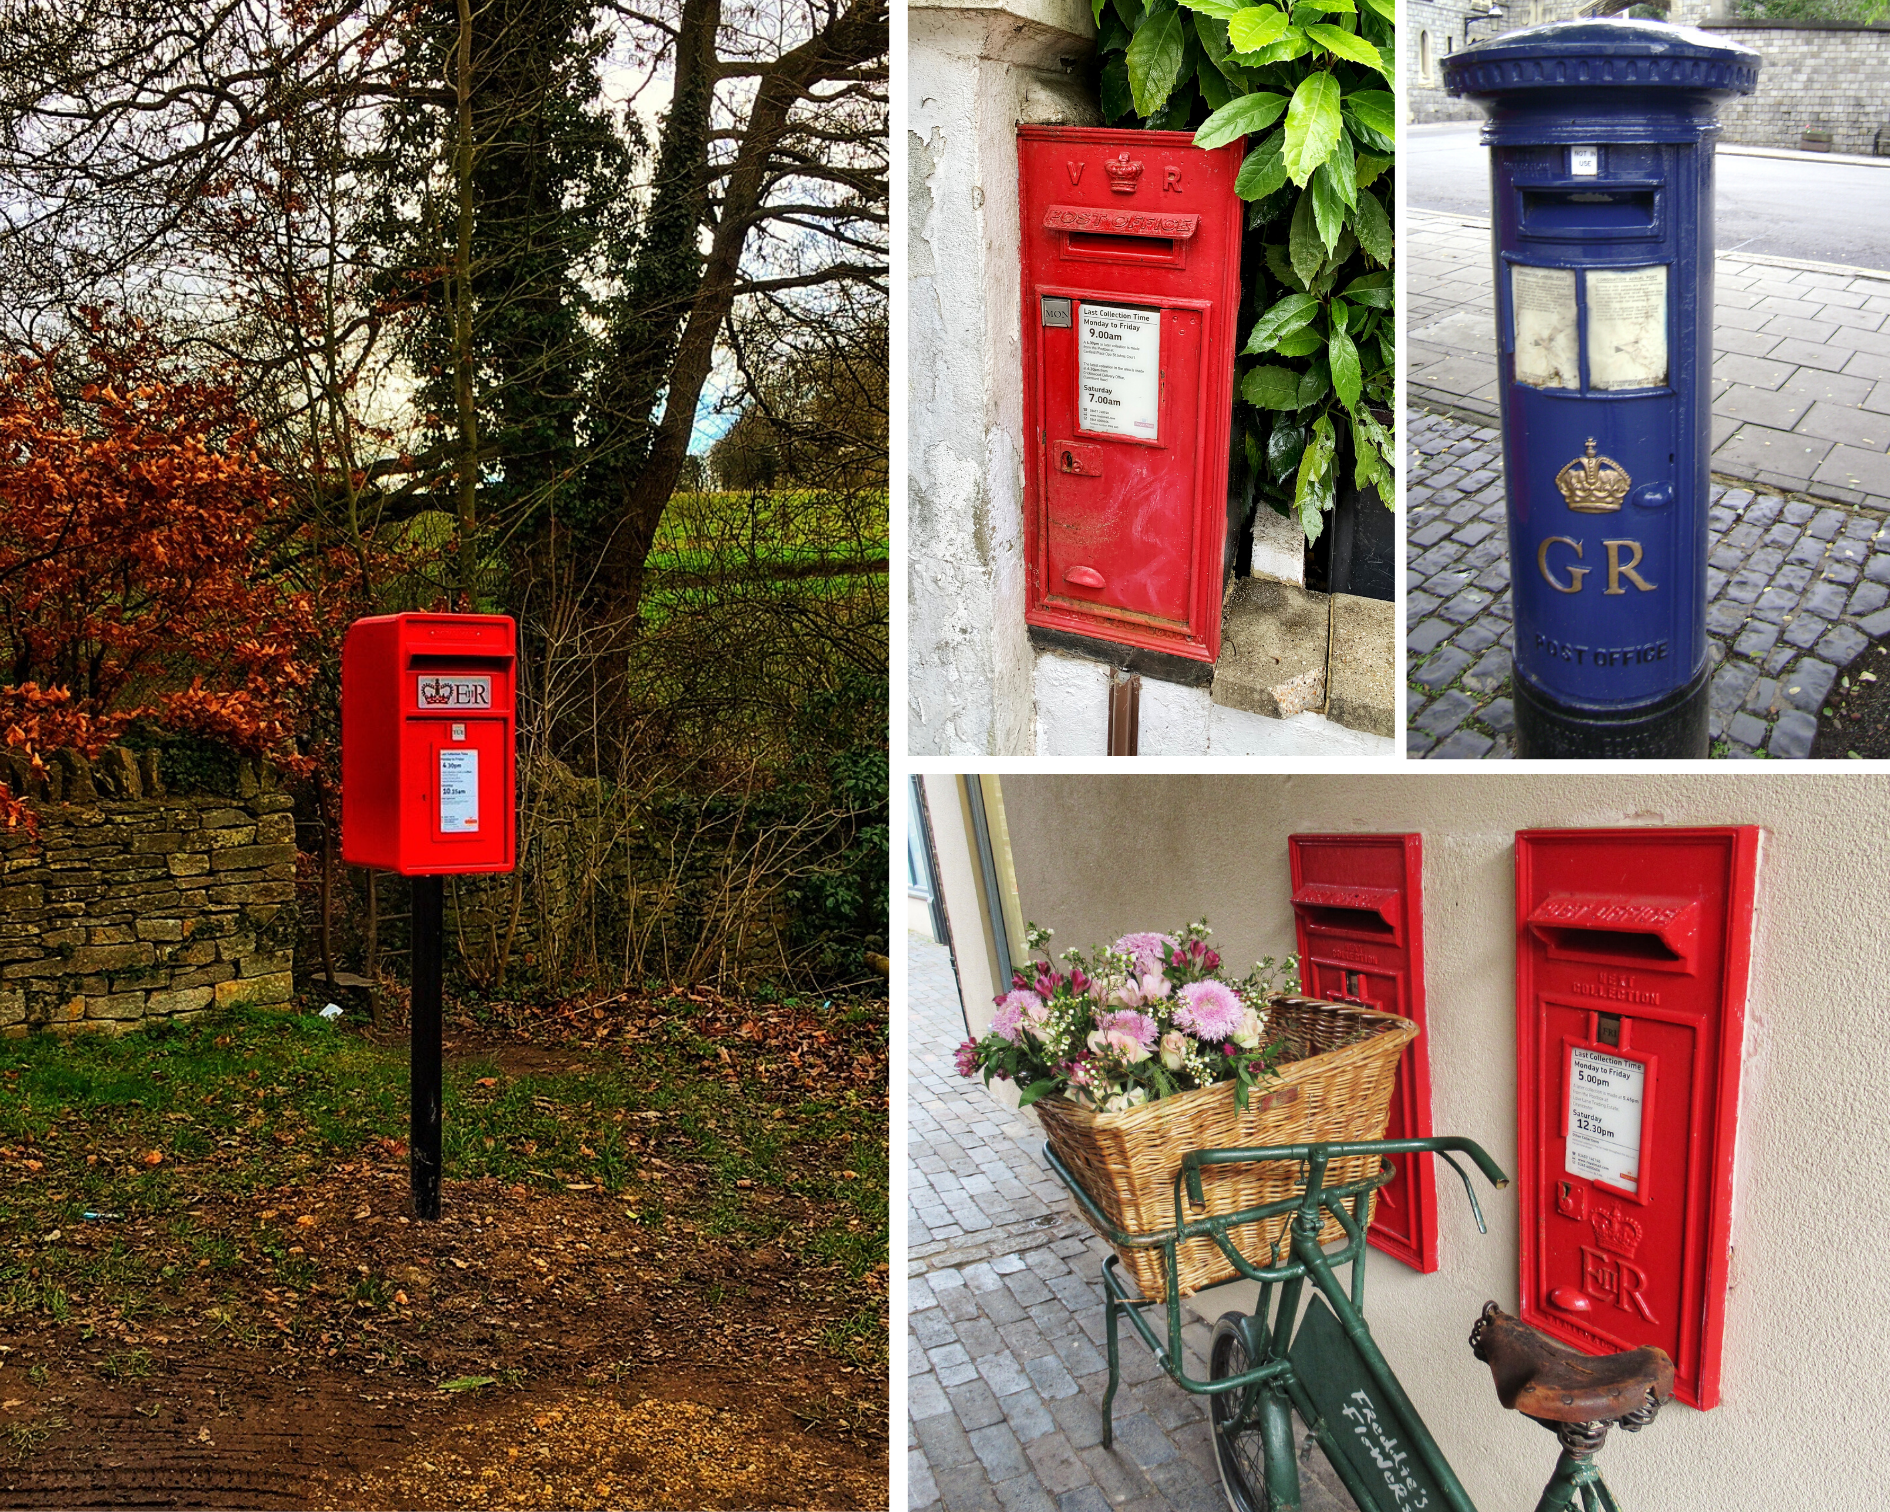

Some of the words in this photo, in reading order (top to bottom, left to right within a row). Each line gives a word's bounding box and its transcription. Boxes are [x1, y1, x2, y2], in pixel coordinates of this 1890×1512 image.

[1066, 161, 1085, 185] V
[1163, 166, 1182, 193] R
[1050, 210, 1108, 226] POST
[1112, 216, 1193, 232] OFFICE
[1046, 310, 1068, 318] MON
[1100, 310, 1131, 319] Collection
[1084, 319, 1109, 328] Monday
[1120, 323, 1140, 332] Friday
[1089, 328, 1122, 341] 9.00am
[1084, 385, 1112, 395] Saturday
[1089, 393, 1120, 406] 7.00am
[1535, 631, 1588, 665] POST
[1594, 638, 1668, 667] OFFICE
[1598, 972, 1635, 988] NEXT
[1573, 982, 1660, 1005] COLLECTION
[1603, 1027, 1616, 1037] FRI
[1575, 1049, 1588, 1058] Last
[1590, 1053, 1622, 1066] Collection
[1624, 1060, 1641, 1070] Time
[1575, 1060, 1599, 1073] Monday
[1609, 1068, 1630, 1080] Friday
[1579, 1070, 1609, 1087] 5.00pm
[1573, 1109, 1602, 1123] Saturday
[1577, 1119, 1614, 1138] 12.30pm
